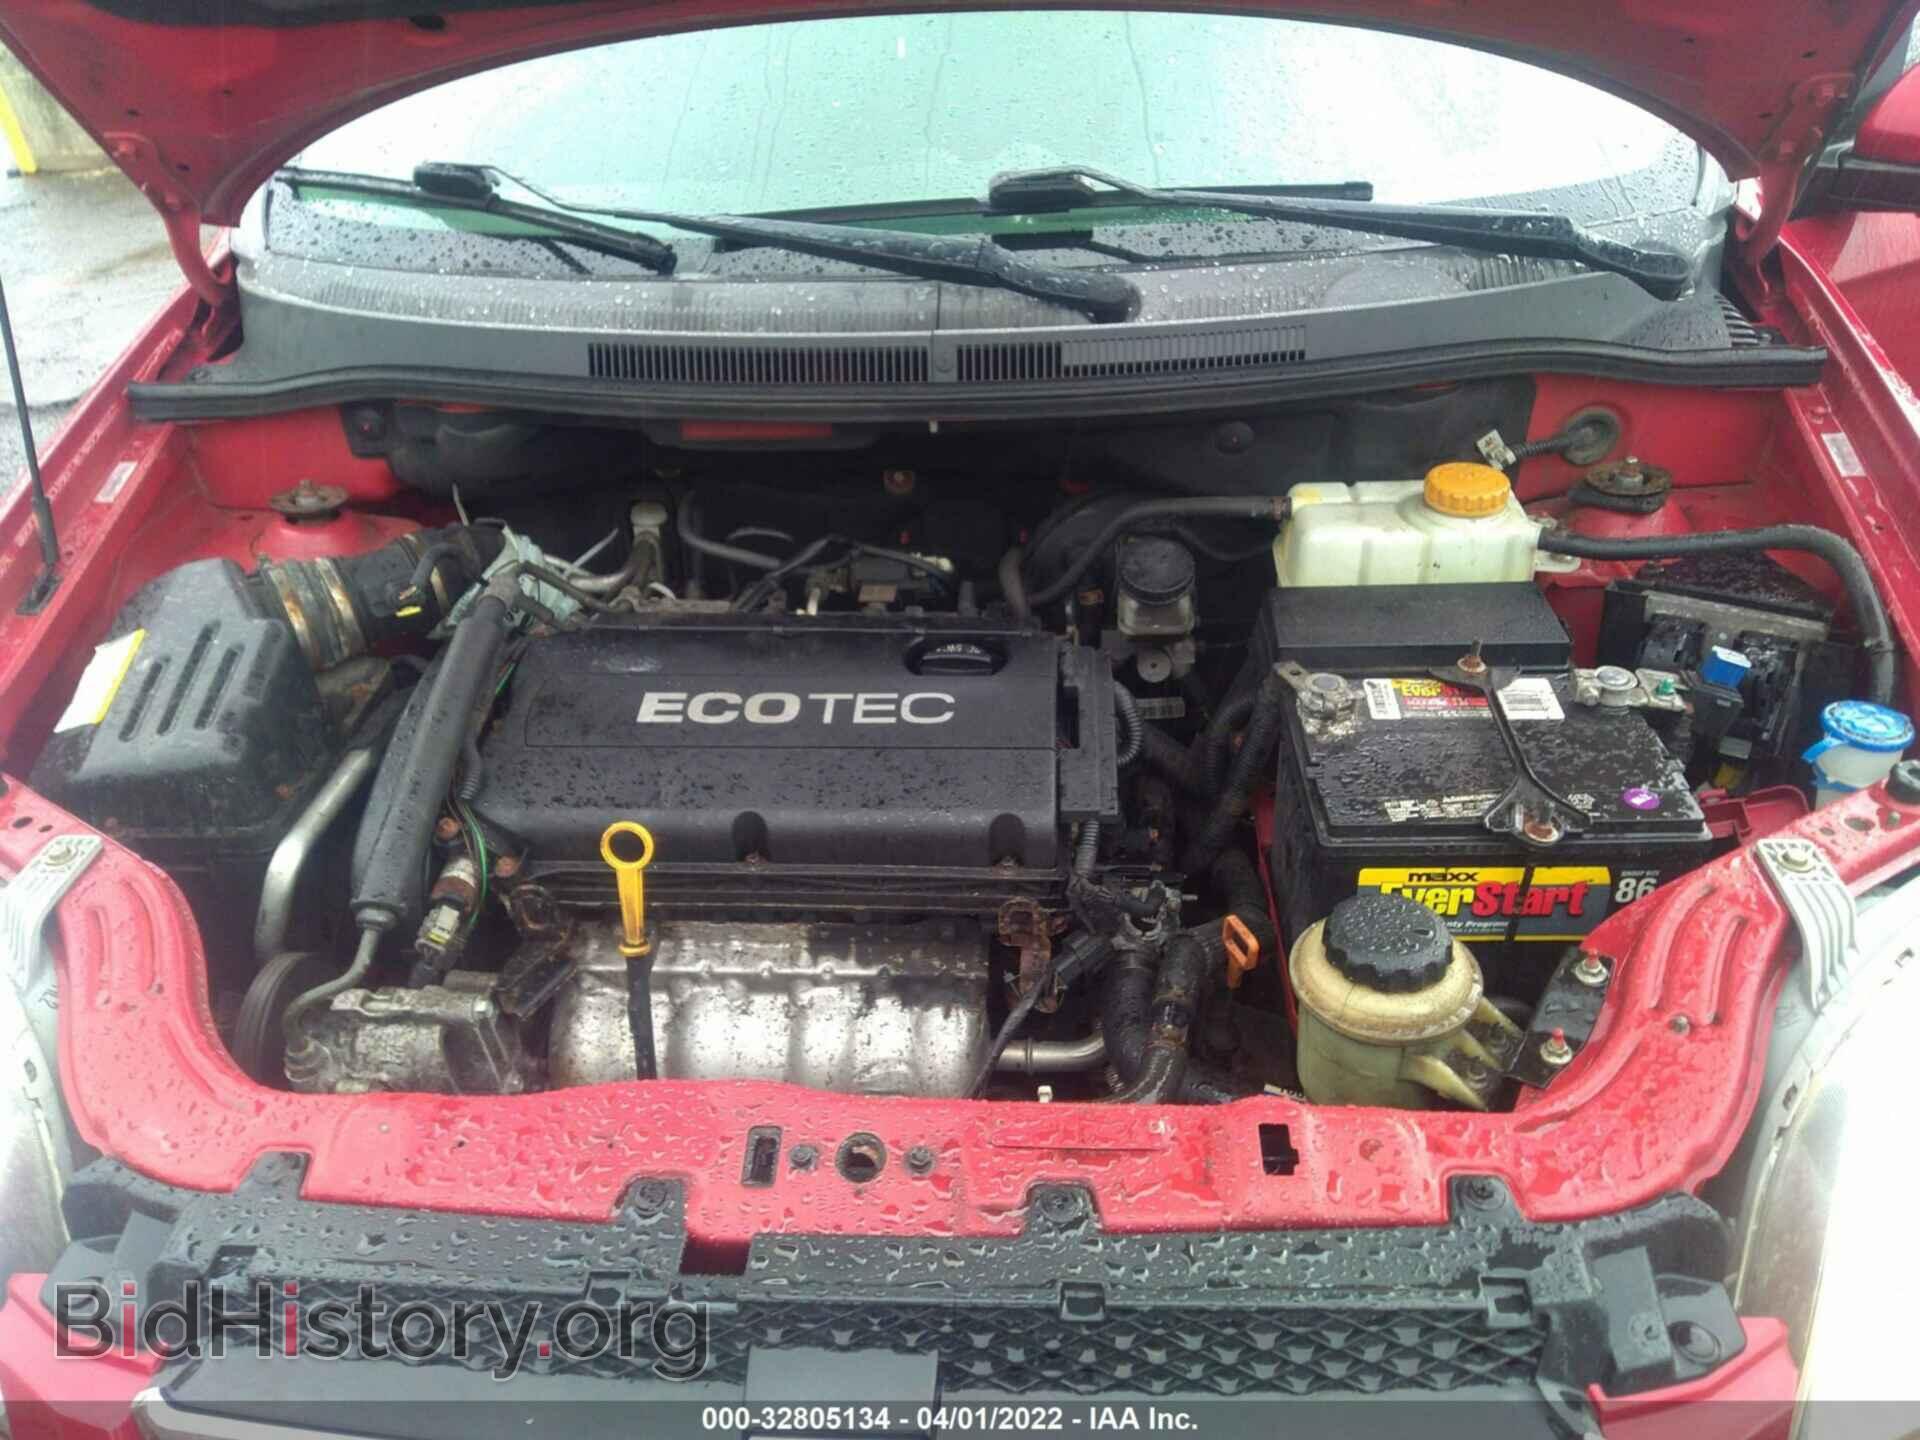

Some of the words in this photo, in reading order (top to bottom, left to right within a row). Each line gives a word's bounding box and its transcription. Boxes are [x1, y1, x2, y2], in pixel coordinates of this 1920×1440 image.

[636, 691, 956, 725] ECOTEC
[1408, 872, 1478, 883] maxx
[1615, 877, 1657, 903] 86
